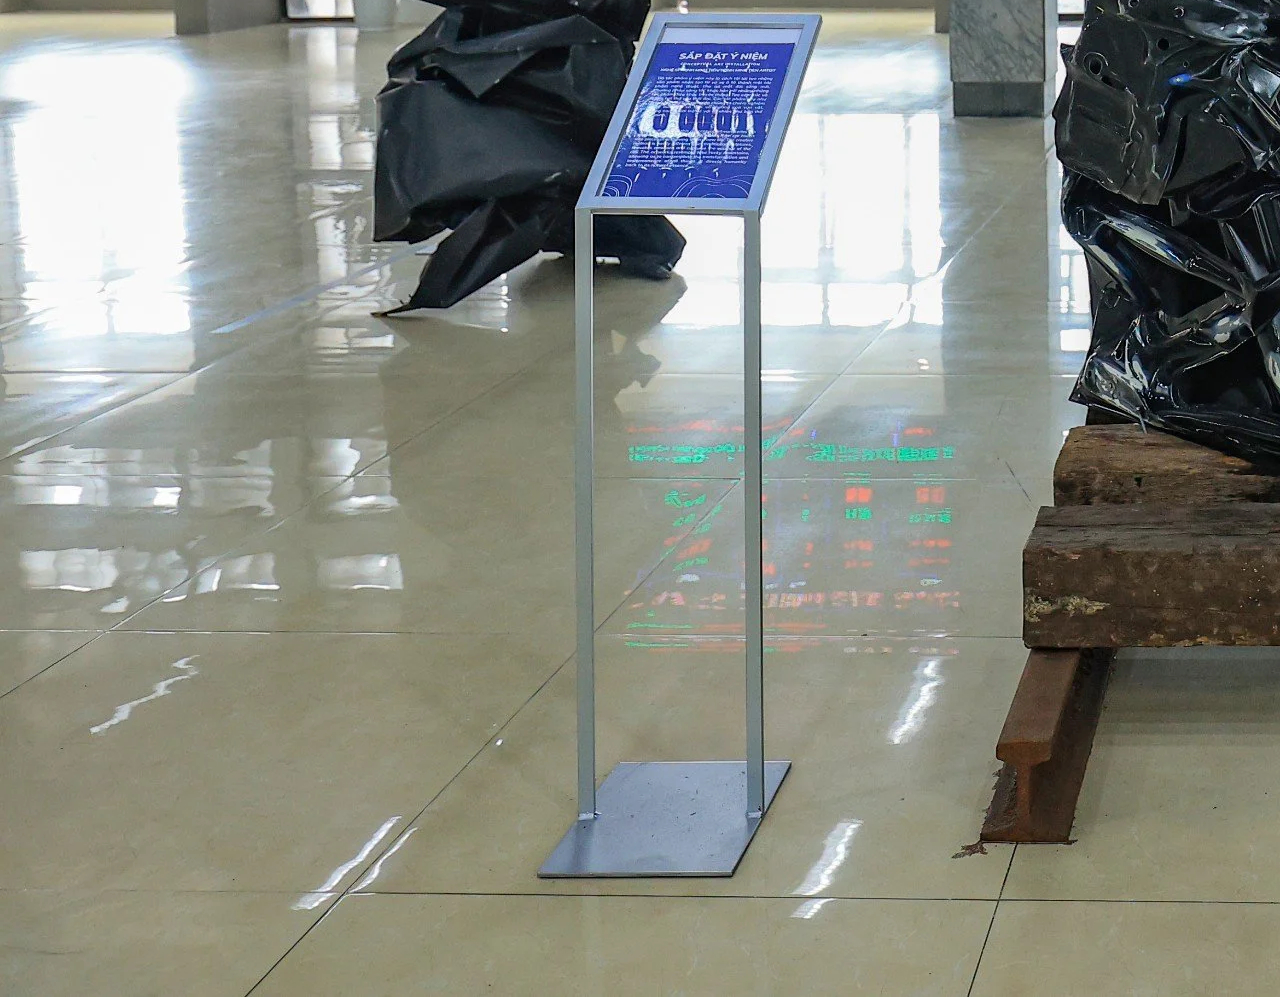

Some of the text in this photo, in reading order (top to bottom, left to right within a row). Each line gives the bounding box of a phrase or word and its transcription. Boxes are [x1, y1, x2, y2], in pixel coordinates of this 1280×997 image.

[679, 51, 768, 61] SẮP ĐẶT Ý NIỆM
